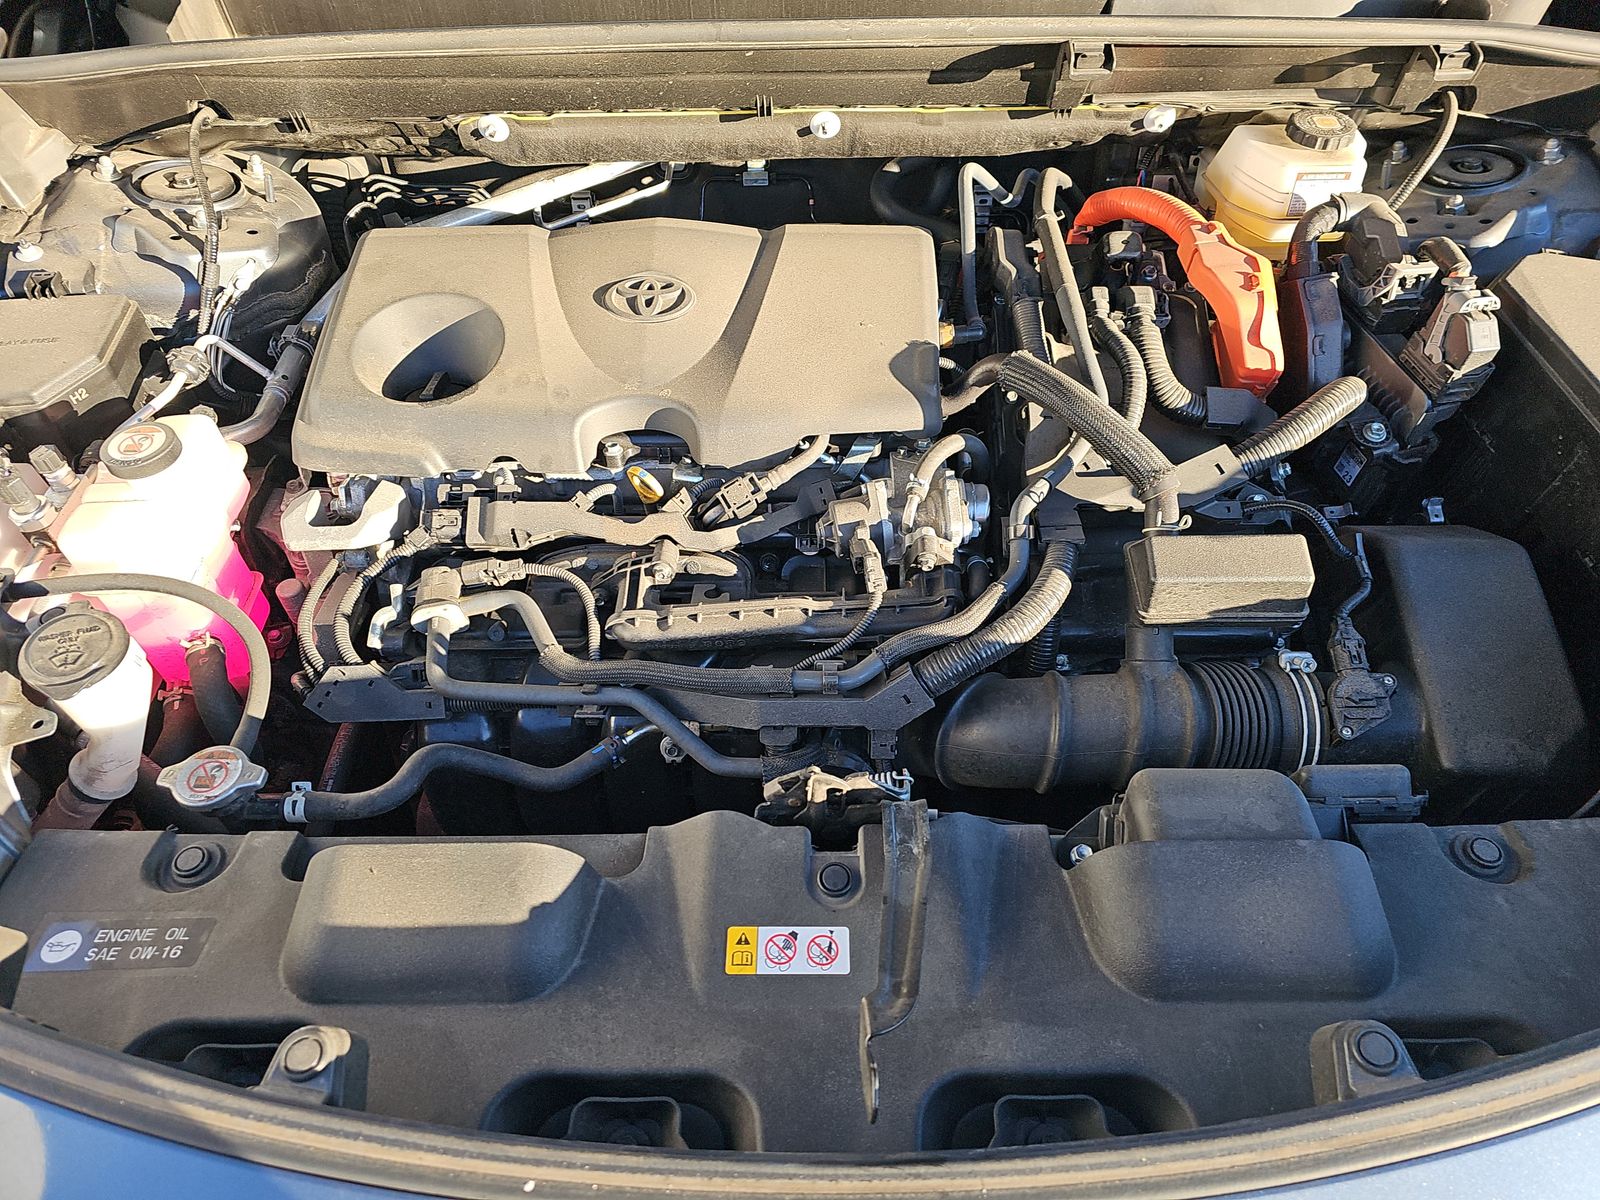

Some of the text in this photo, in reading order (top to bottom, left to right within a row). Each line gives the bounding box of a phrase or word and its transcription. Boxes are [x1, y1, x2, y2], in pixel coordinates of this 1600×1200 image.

[69, 387, 90, 405] H2
[93, 927, 190, 943] ENGINE OIL
[84, 945, 184, 962] SAE 0W-16
